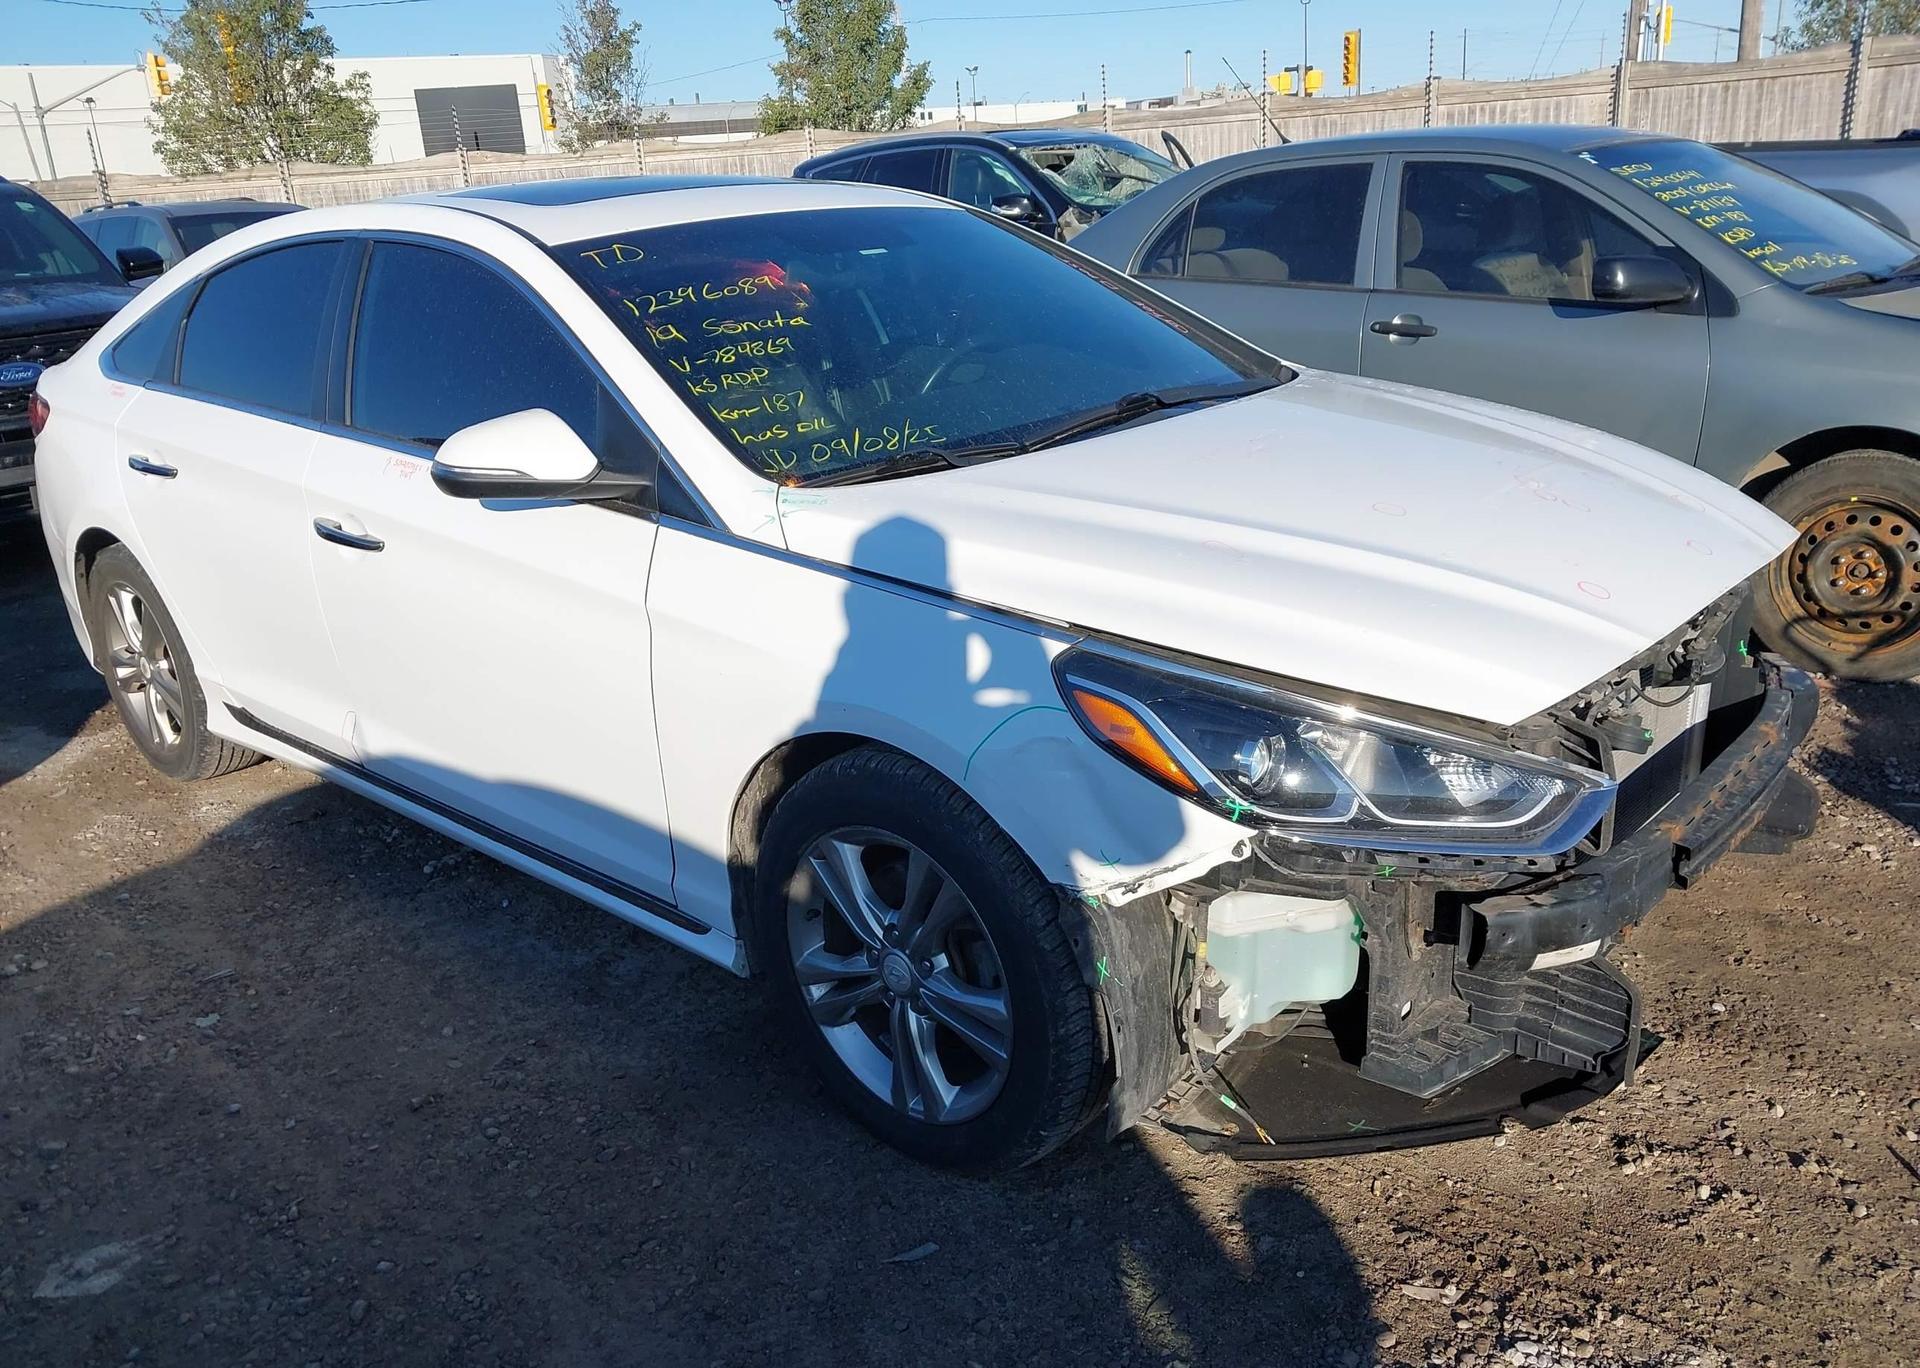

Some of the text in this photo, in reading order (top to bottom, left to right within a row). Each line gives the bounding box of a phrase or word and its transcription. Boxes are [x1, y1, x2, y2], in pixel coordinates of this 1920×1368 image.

[623, 275, 777, 317] 12396089
[702, 310, 813, 338] Sonata
[730, 424, 789, 445] has
